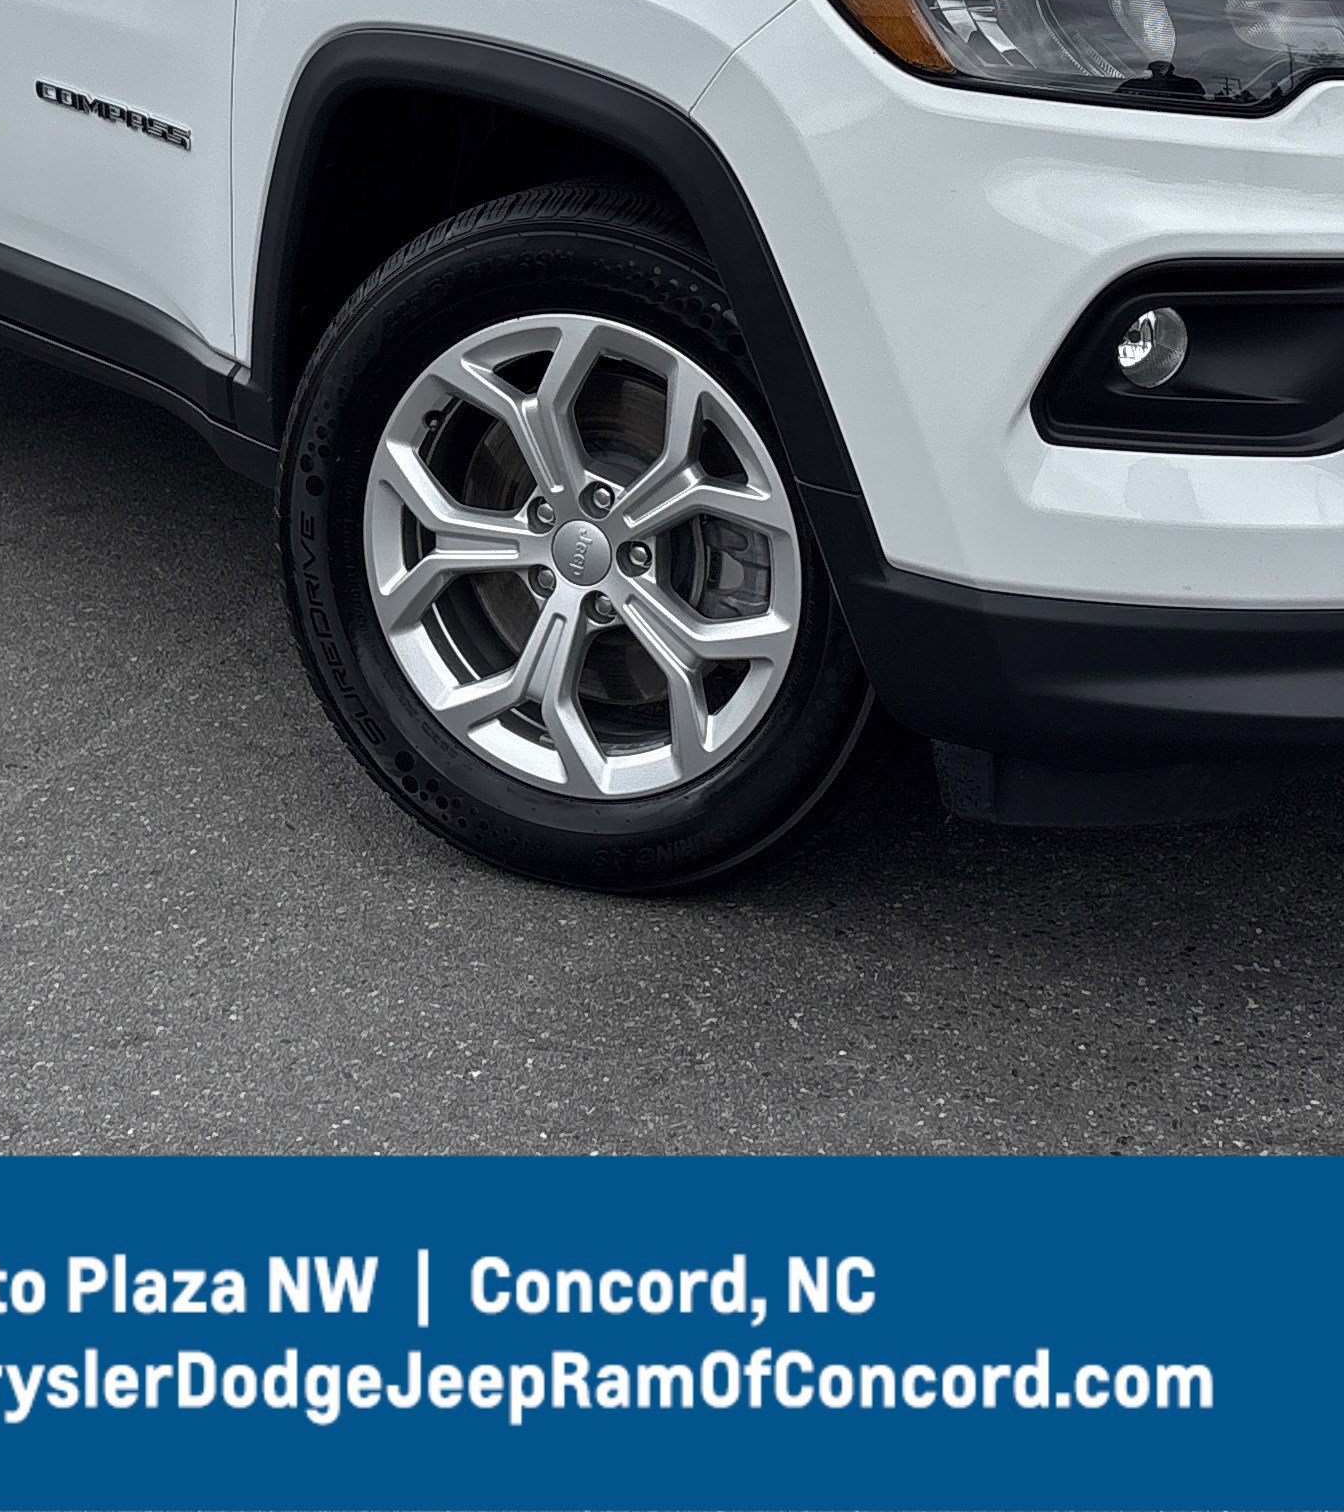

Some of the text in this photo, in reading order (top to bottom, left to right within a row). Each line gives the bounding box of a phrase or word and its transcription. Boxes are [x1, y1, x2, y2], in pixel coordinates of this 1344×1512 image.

[35, 79, 192, 152] COMPASS
[569, 528, 594, 576] Jeep
[299, 510, 390, 747] SUREDRIVE
